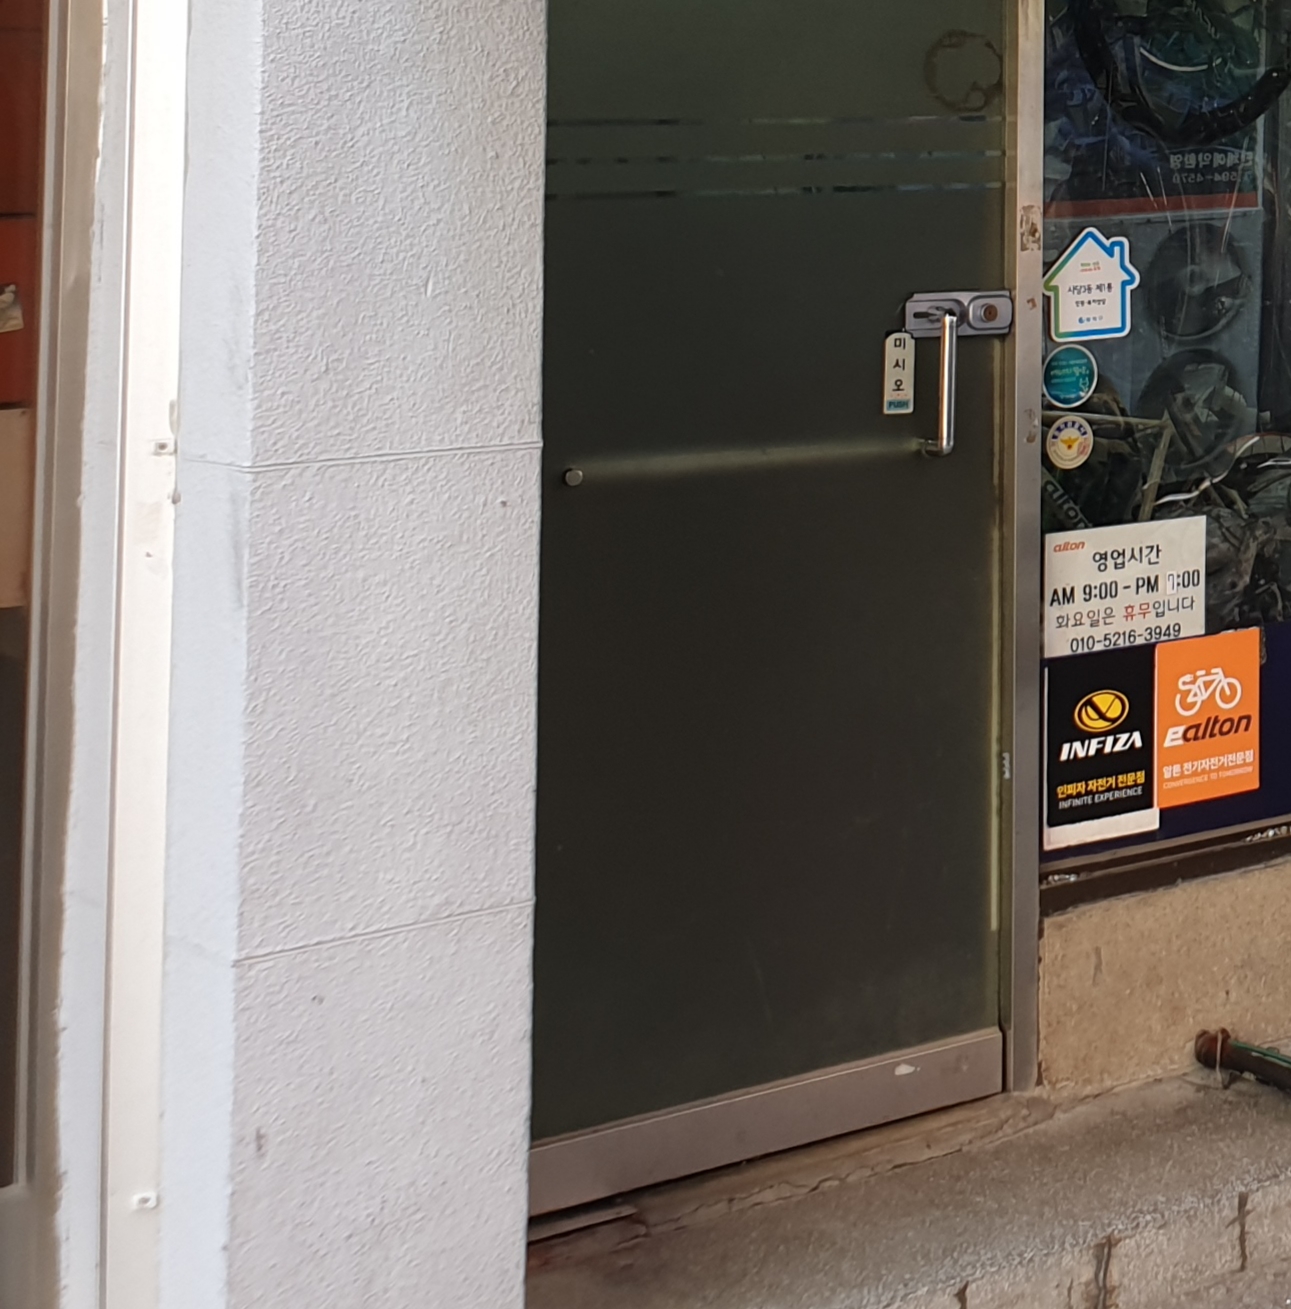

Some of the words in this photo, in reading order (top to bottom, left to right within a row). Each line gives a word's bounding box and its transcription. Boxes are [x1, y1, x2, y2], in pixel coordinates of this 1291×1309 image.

[892, 337, 906, 392] 미시오
[1053, 541, 1086, 553] alton
[1092, 544, 1162, 572] 영업시간
[1050, 586, 1075, 607] AM
[1083, 580, 1118, 602] 9:00
[1135, 574, 1159, 595] PM
[1055, 606, 1116, 629] 화요일은
[1122, 595, 1195, 622] 휴무입니다
[1070, 622, 1182, 653] 010-5216-3949
[1059, 730, 1143, 762] INFIZA
[1056, 781, 1086, 798] 인피자
[1087, 775, 1116, 793] 자전거
[1117, 770, 1146, 788] 전문점
[1058, 795, 1093, 810] INFINITE
[1094, 785, 1143, 803] EXPERIENCE
